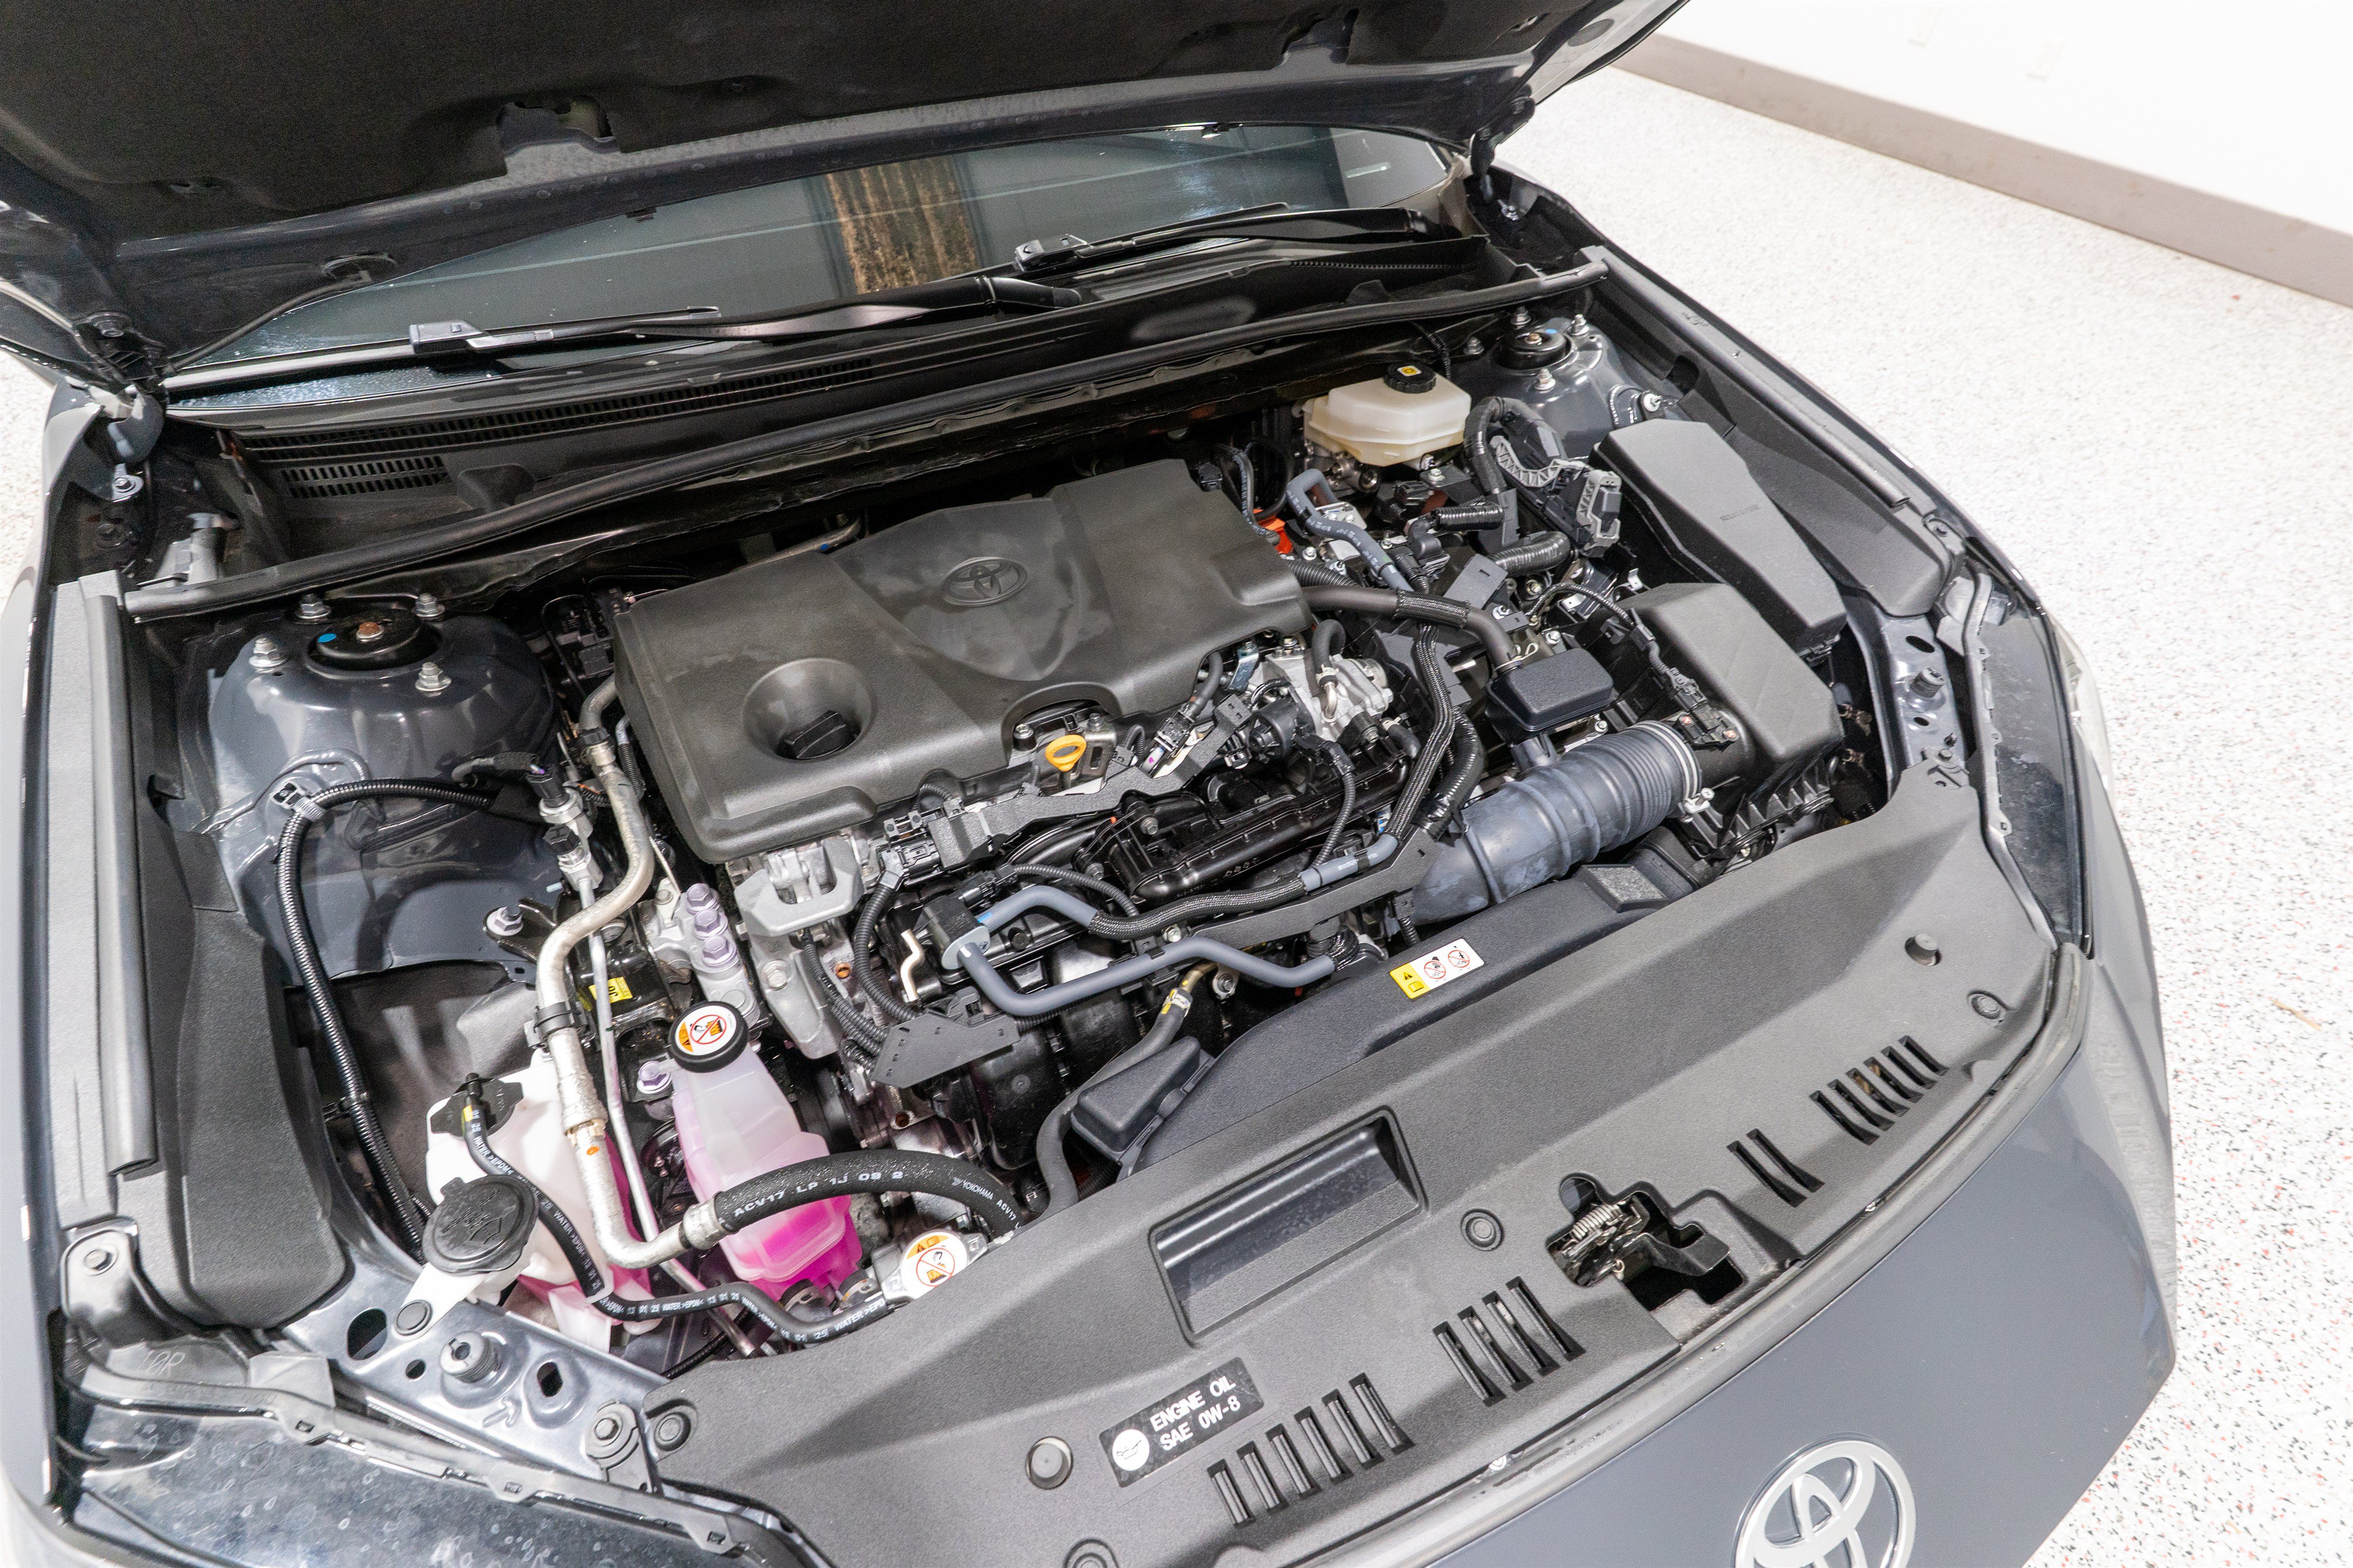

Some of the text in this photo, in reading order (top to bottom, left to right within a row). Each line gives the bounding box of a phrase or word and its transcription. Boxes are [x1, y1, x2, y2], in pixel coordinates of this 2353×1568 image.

[734, 1190, 785, 1217] ACV17
[796, 1181, 819, 1194] LP
[831, 1175, 848, 1185] 1J
[892, 1171, 904, 1179] 2
[996, 1199, 1016, 1221] ACV17
[833, 1311, 865, 1331] WATER
[1149, 1376, 1236, 1432] ENGINE OIL
[1159, 1395, 1241, 1450] SAE 0W-8
